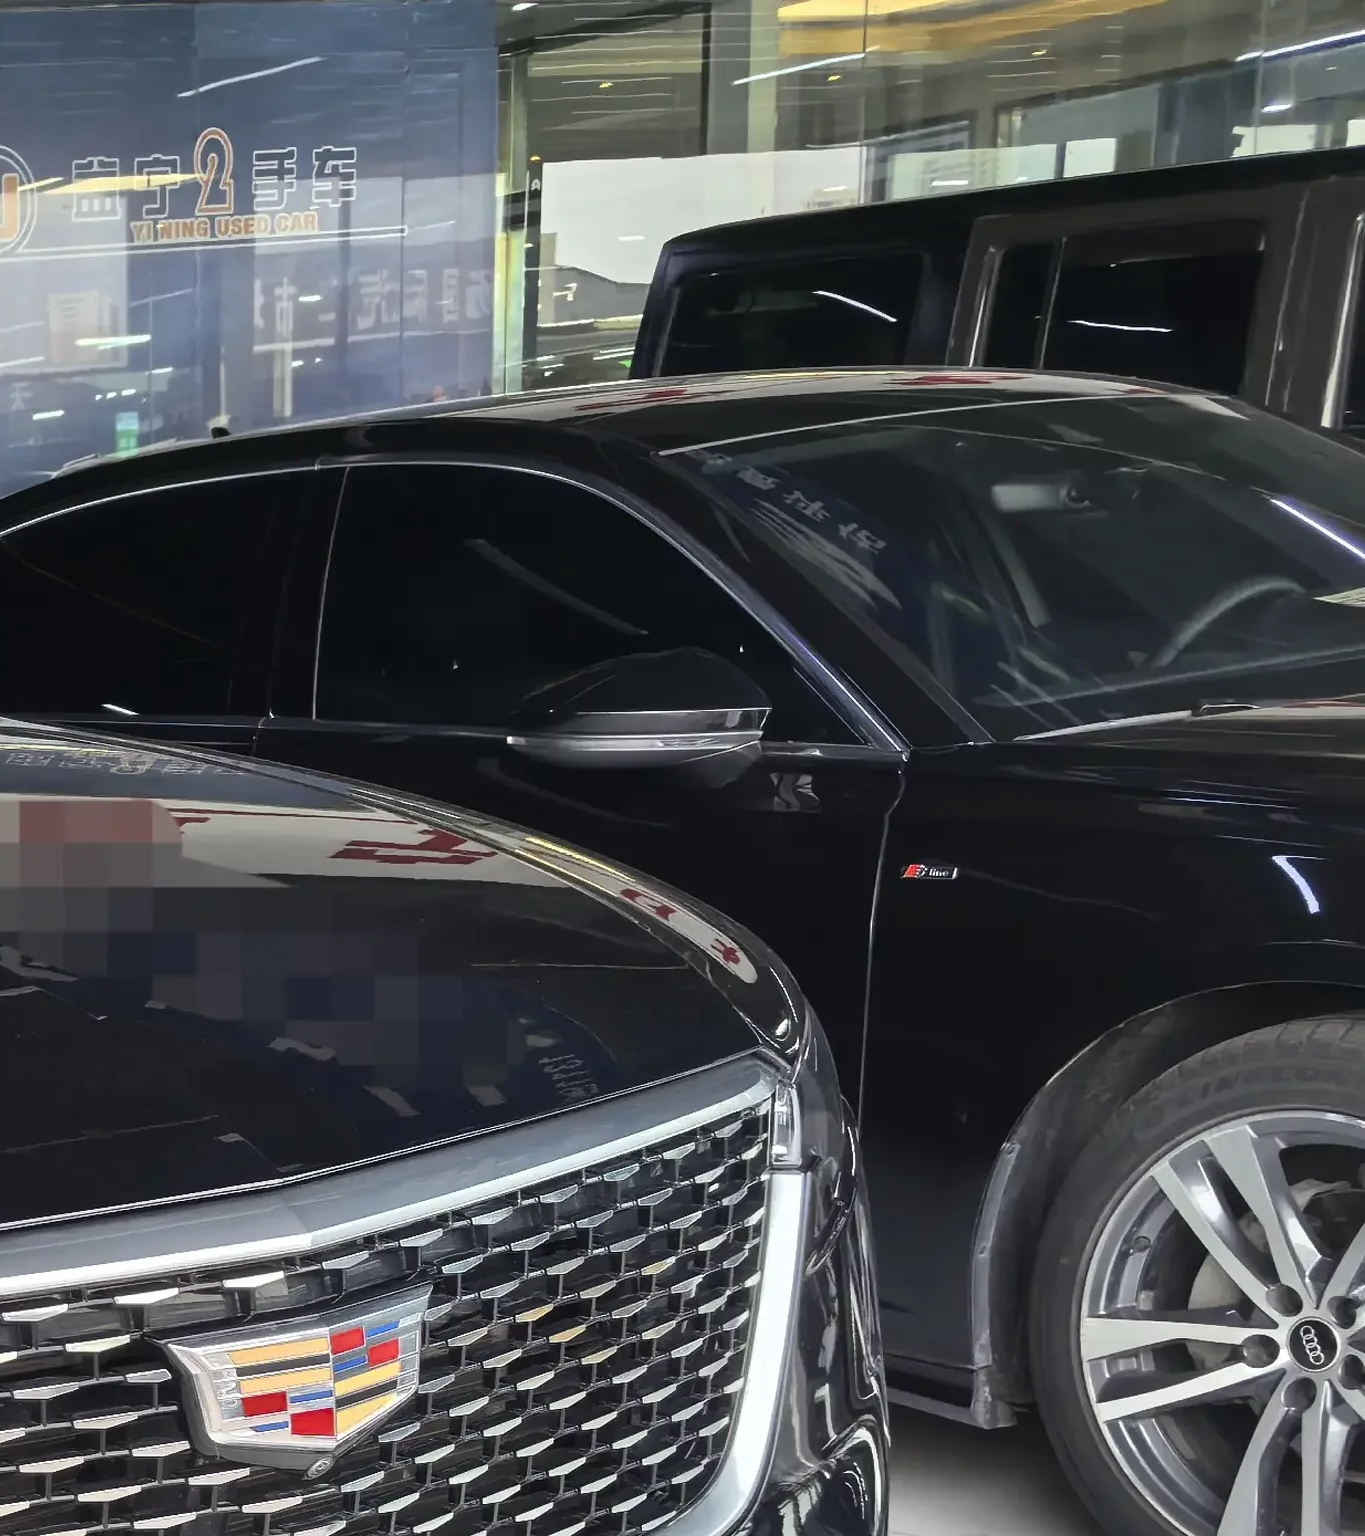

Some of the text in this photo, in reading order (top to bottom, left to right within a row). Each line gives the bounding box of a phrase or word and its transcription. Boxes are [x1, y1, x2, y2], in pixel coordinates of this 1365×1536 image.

[130, 210, 318, 244] YI NING USED CAR
